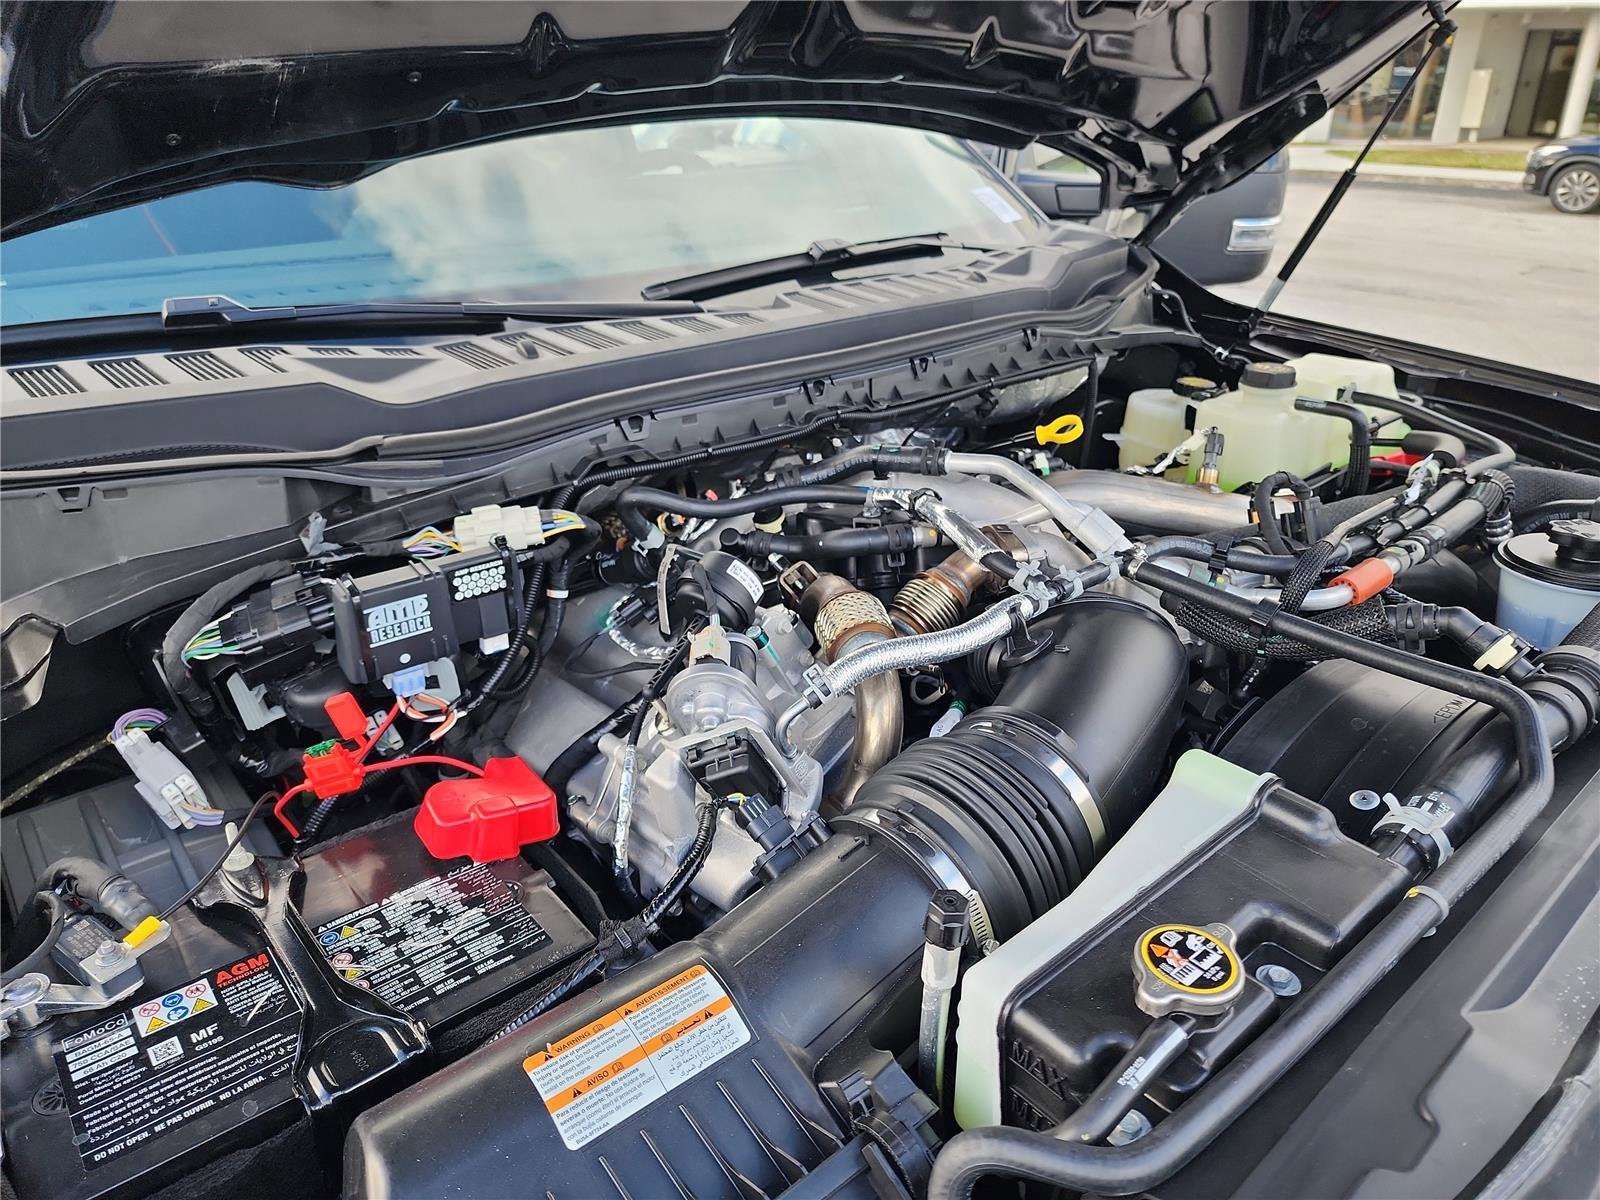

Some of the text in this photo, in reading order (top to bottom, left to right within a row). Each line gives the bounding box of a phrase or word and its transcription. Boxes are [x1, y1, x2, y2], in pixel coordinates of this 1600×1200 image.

[469, 559, 503, 573] RESEARCH
[368, 597, 429, 629] AMP
[370, 615, 431, 643] RESEARCH
[213, 954, 269, 982] AGM
[217, 963, 270, 987] TECHNOLOGY
[635, 974, 689, 1008] AVERTISSEMENT
[65, 1018, 125, 1049] FoMoCo
[74, 1032, 122, 1057] BAGM-65-A
[190, 1022, 219, 1043] MF
[554, 1030, 590, 1054] WARNING
[72, 1040, 129, 1069] 750 CCA/SAE
[109, 1051, 126, 1063] C20
[585, 1069, 609, 1087] AVISO
[1012, 1040, 1068, 1099] MAX
[83, 1108, 101, 1121] Made
[109, 1097, 124, 1108] USA
[123, 1091, 138, 1102] with
[148, 1080, 160, 1090] and
[219, 1074, 266, 1101] NO LA ABRA.
[153, 1098, 216, 1132] NE PAS OUVRIR.
[555, 1107, 569, 1119] Para
[1012, 1093, 1058, 1133] MI
[93, 1130, 151, 1161] DO NOT OPEN.
